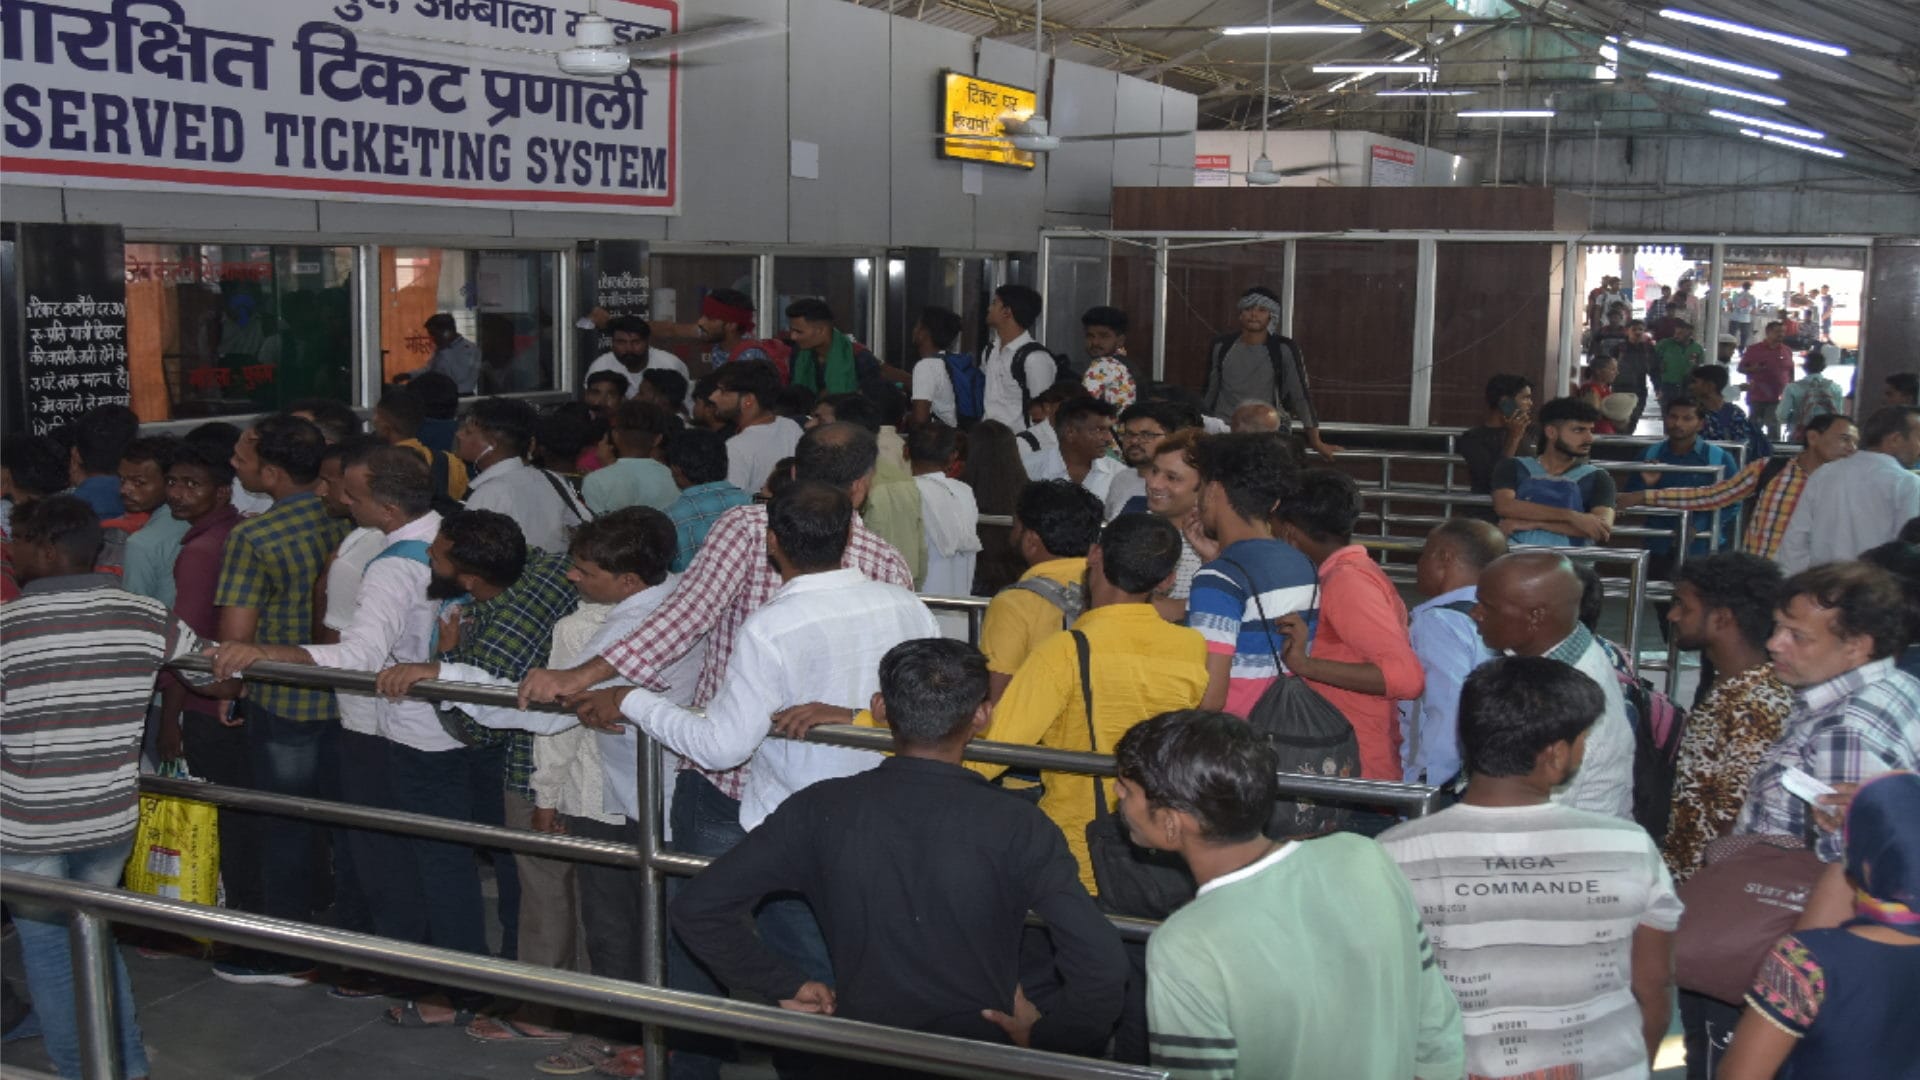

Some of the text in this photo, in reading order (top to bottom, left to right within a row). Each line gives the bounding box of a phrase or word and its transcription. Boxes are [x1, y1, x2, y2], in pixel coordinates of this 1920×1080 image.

[293, 21, 469, 114] टिकट
[482, 67, 648, 131] प्रणाली
[966, 82, 1020, 112] टिकट घर
[3, 83, 668, 191] SERVED TICKETING SYSTEM
[1454, 879, 1601, 897] COMMANDE
